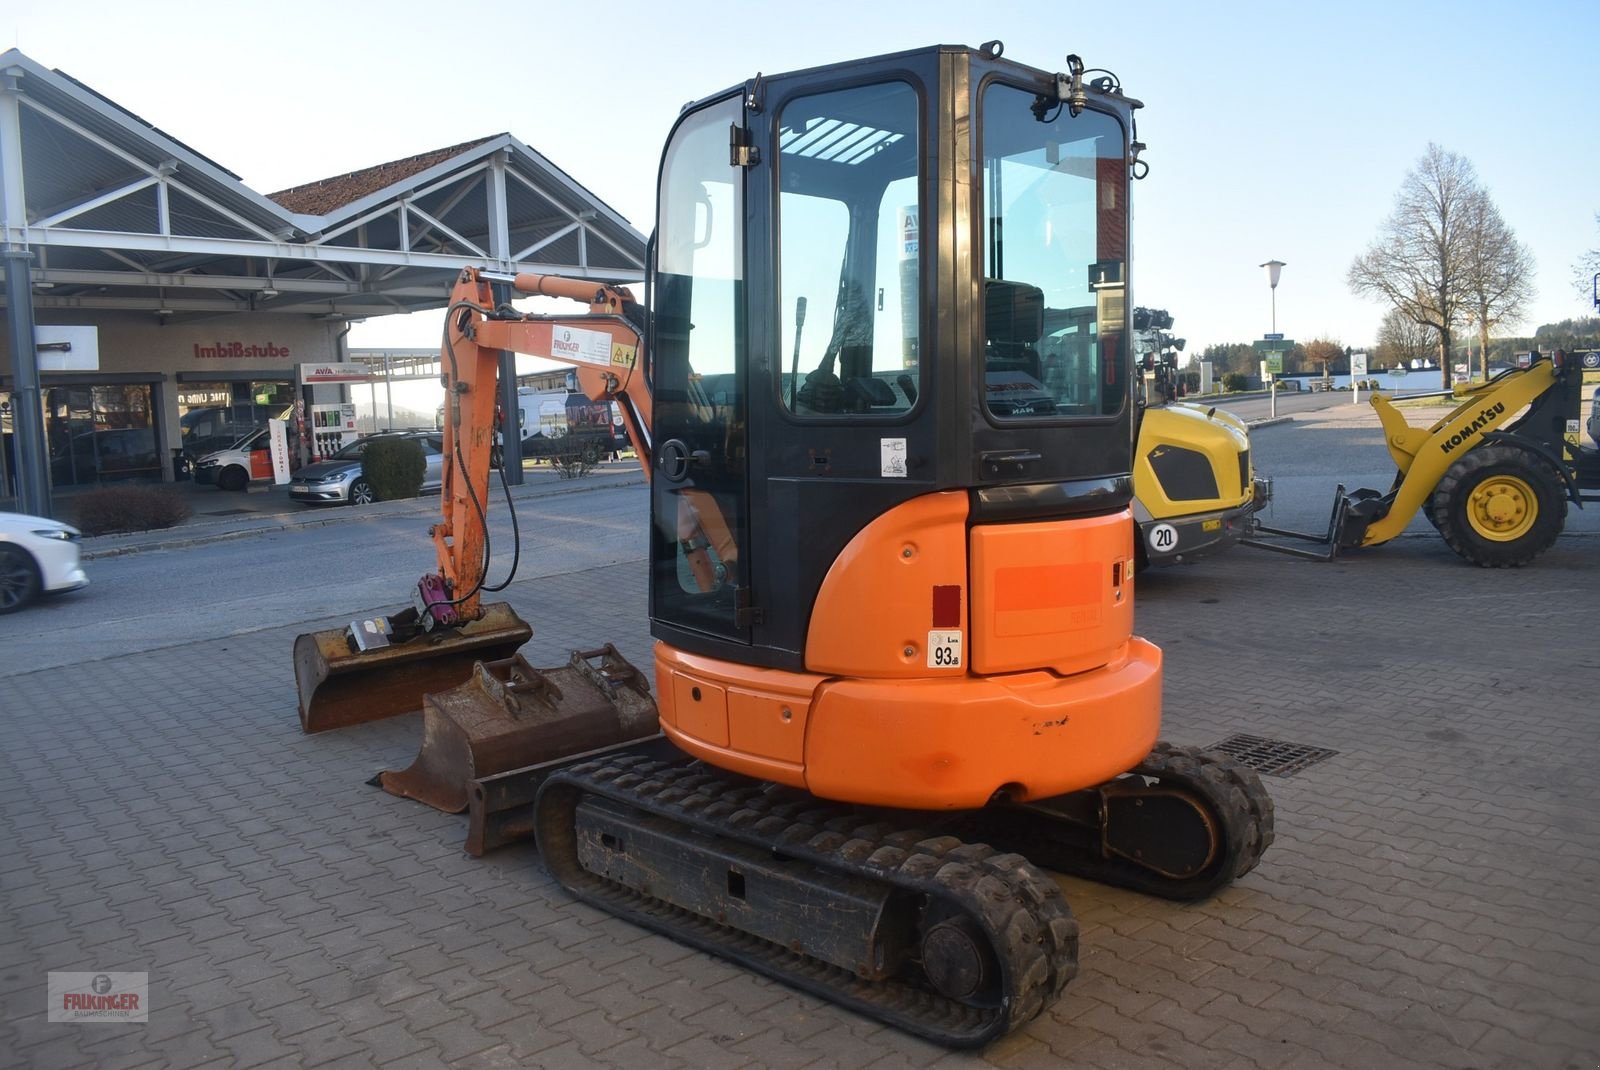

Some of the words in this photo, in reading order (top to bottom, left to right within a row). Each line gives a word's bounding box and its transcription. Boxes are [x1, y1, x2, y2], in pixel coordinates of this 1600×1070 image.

[193, 342, 290, 358] Imbißstube
[315, 366, 333, 375] AVIA
[1440, 402, 1505, 454] KOMATSU
[1156, 529, 1173, 546] 20
